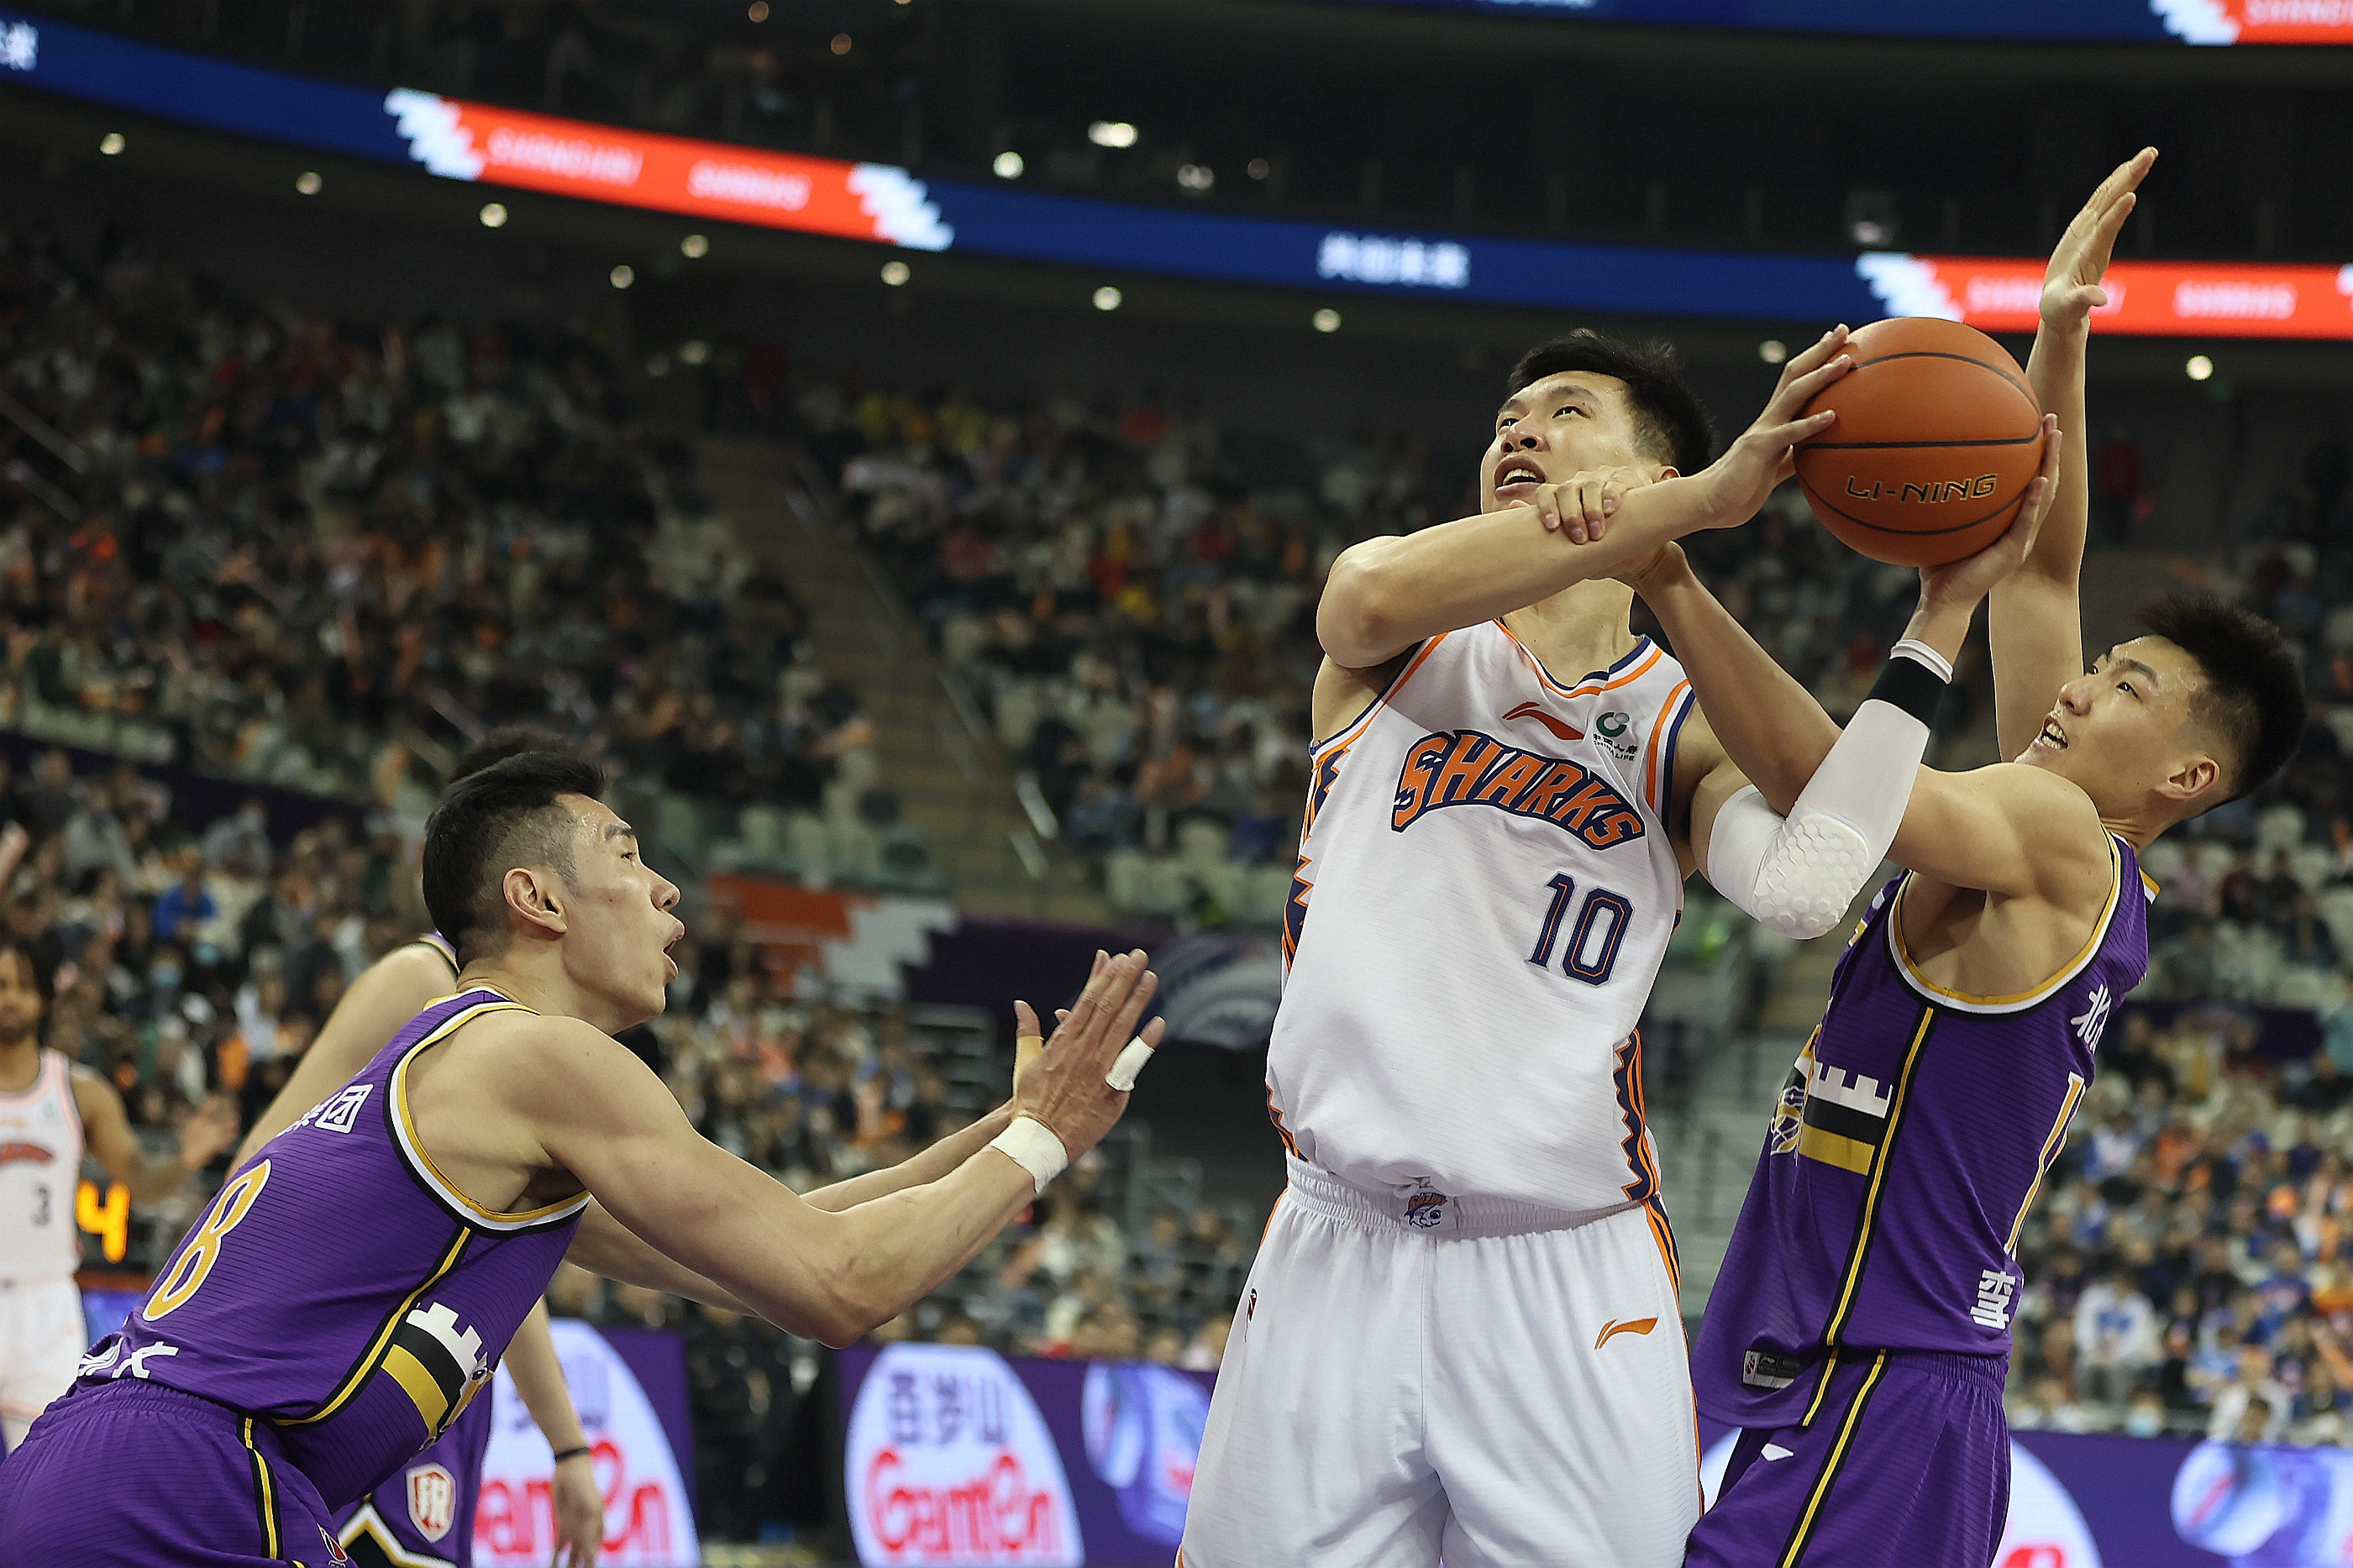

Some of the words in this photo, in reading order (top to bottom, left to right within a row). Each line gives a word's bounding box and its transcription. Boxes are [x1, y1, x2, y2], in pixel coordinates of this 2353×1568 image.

[1846, 474, 1998, 504] LI-NING
[1390, 729, 1646, 851] SHARKS
[1526, 871, 1636, 987] 10
[76, 1179, 131, 1263] 4
